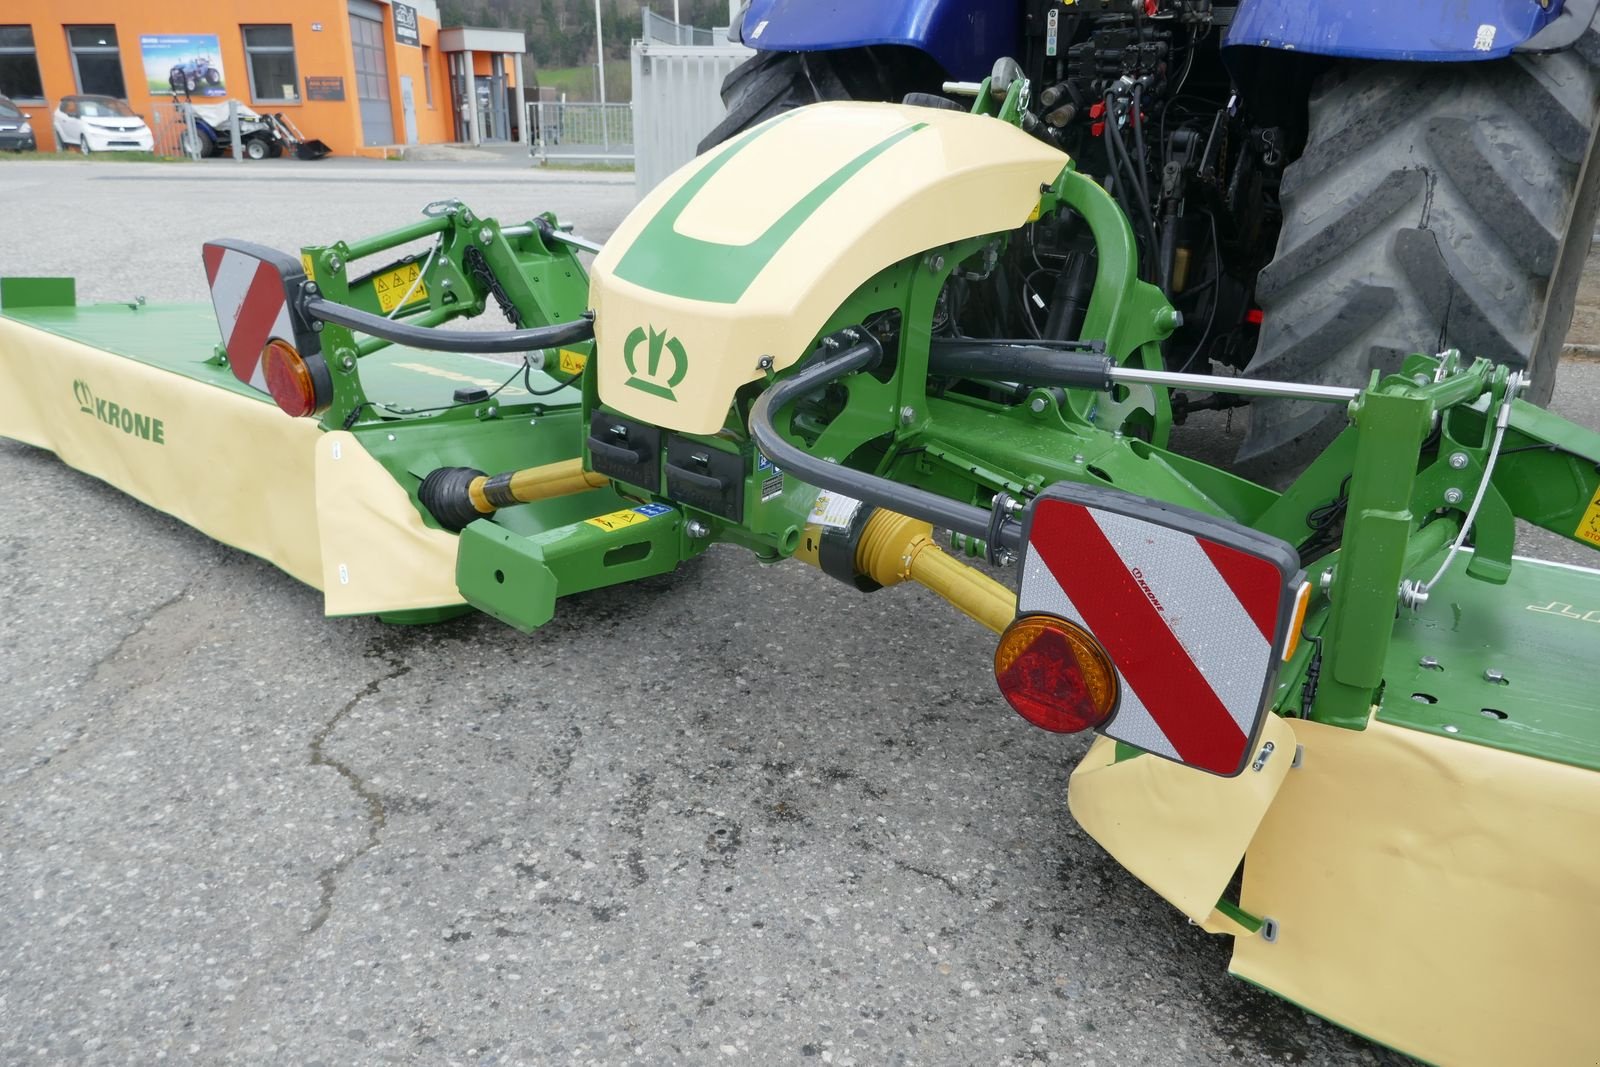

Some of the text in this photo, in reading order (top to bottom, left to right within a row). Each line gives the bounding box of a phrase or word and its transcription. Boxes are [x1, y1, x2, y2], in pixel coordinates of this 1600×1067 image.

[96, 397, 165, 445] KRONE
[1584, 530, 1600, 542] STO
[1137, 579, 1165, 612] KRONE
